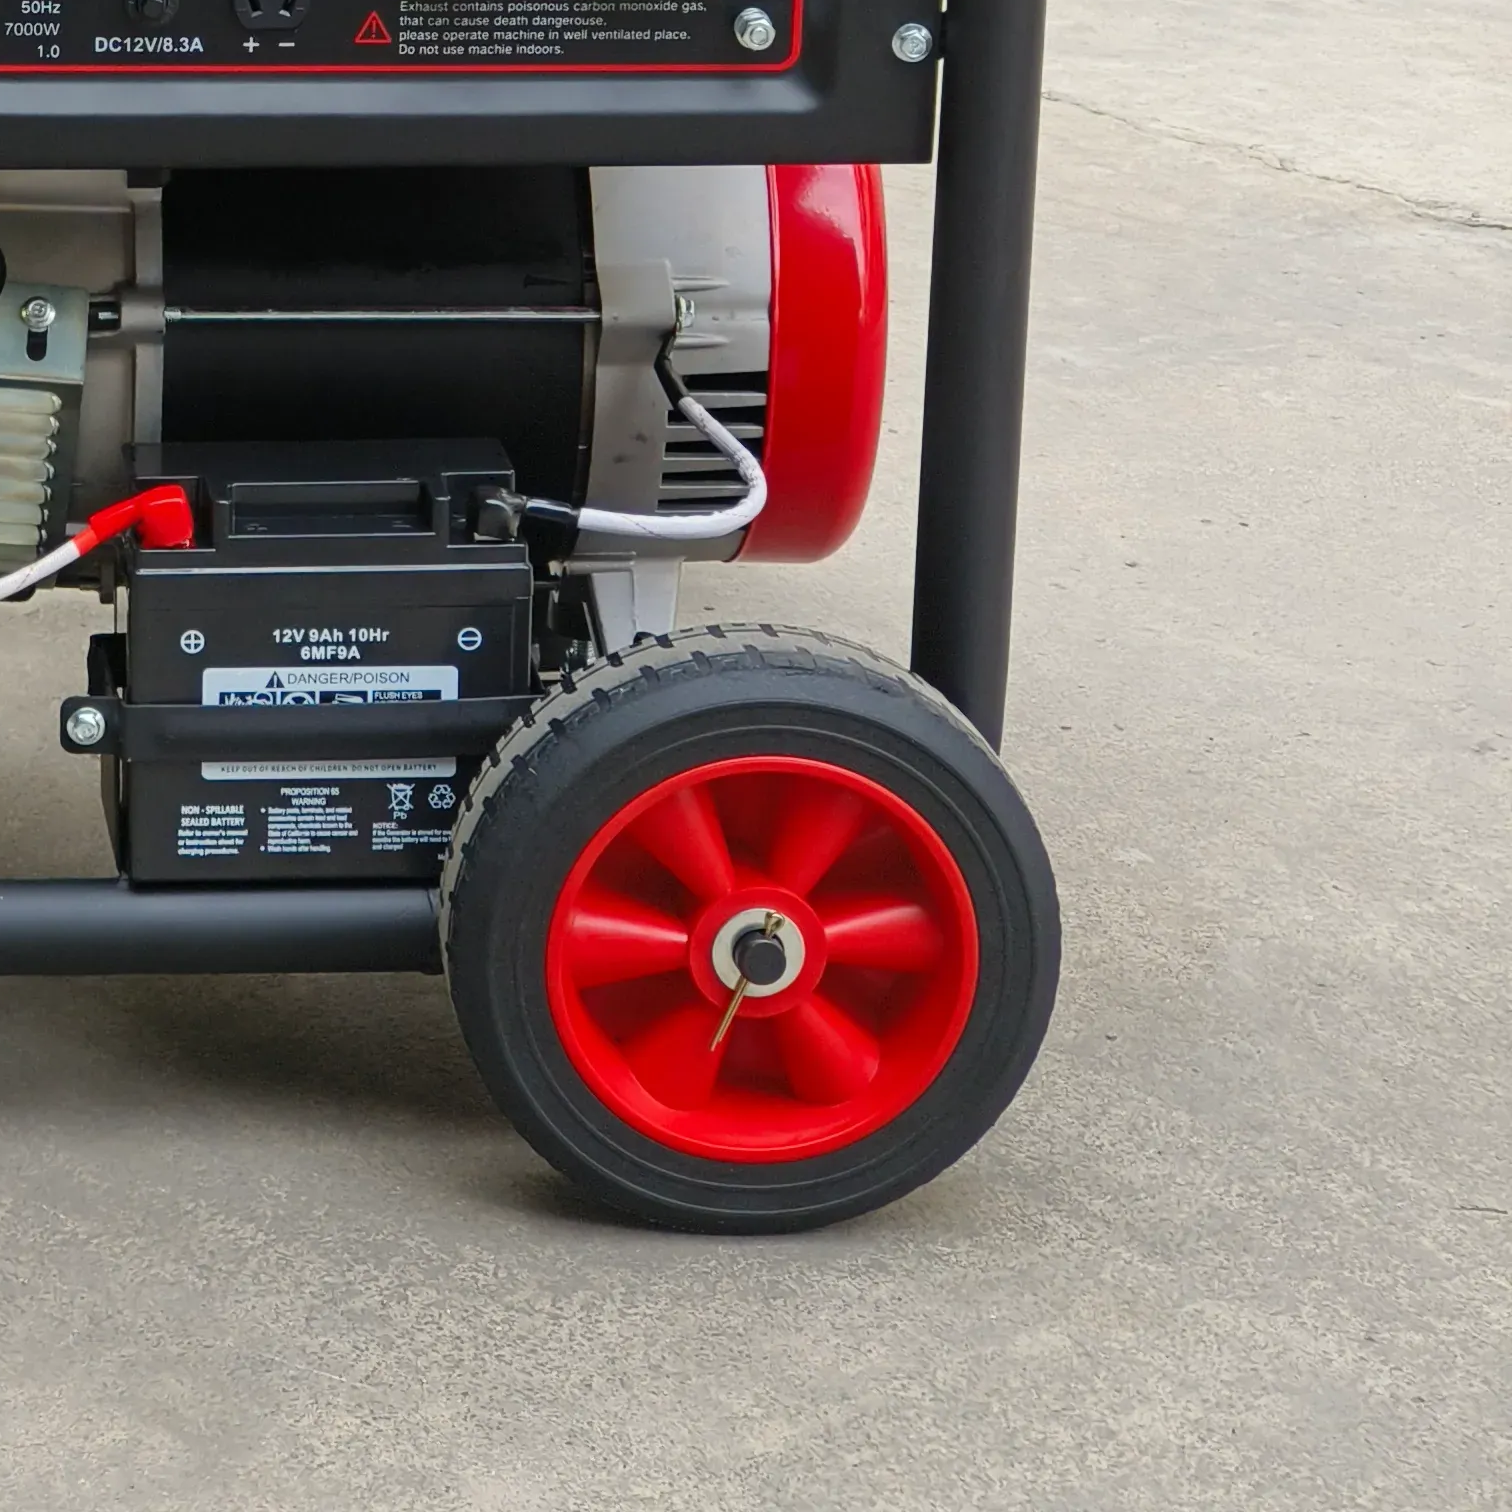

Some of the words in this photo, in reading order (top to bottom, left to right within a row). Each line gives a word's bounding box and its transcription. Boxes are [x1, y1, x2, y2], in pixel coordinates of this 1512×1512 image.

[21, 1, 61, 14] 50Hz
[400, 1, 448, 12] Exhaust
[452, 1, 504, 12] contains
[508, 1, 569, 13] poisonous
[573, 2, 616, 12] carbon
[620, 1, 678, 12] monoxide
[399, 16, 424, 26] that
[428, 17, 450, 26] can
[453, 17, 489, 26] cause
[493, 15, 528, 26] death
[4, 23, 60, 36] 7000W
[399, 30, 439, 42] please
[443, 31, 489, 42] operate
[493, 30, 545, 40] machine
[548, 29, 559, 40] in
[563, 29, 588, 40] well
[591, 29, 651, 40] ventilated
[654, 29, 691, 41] place.
[95, 37, 204, 53] DC12V/8.3A
[399, 44, 415, 55] Do
[419, 44, 439, 55] not
[443, 45, 464, 55] use
[468, 43, 512, 55] machie
[516, 44, 564, 55] indoors.
[37, 45, 60, 59] 1.0
[272, 629, 305, 643] 12V
[309, 628, 343, 643] 9Ah
[348, 628, 390, 642] 10Hr
[300, 645, 361, 660] 6MF9A
[288, 672, 410, 685] DANGER/POISON
[291, 797, 326, 806] WARNING
[181, 817, 209, 826] SEALED
[211, 817, 245, 826] BATTERY
[393, 811, 408, 820] Pb
